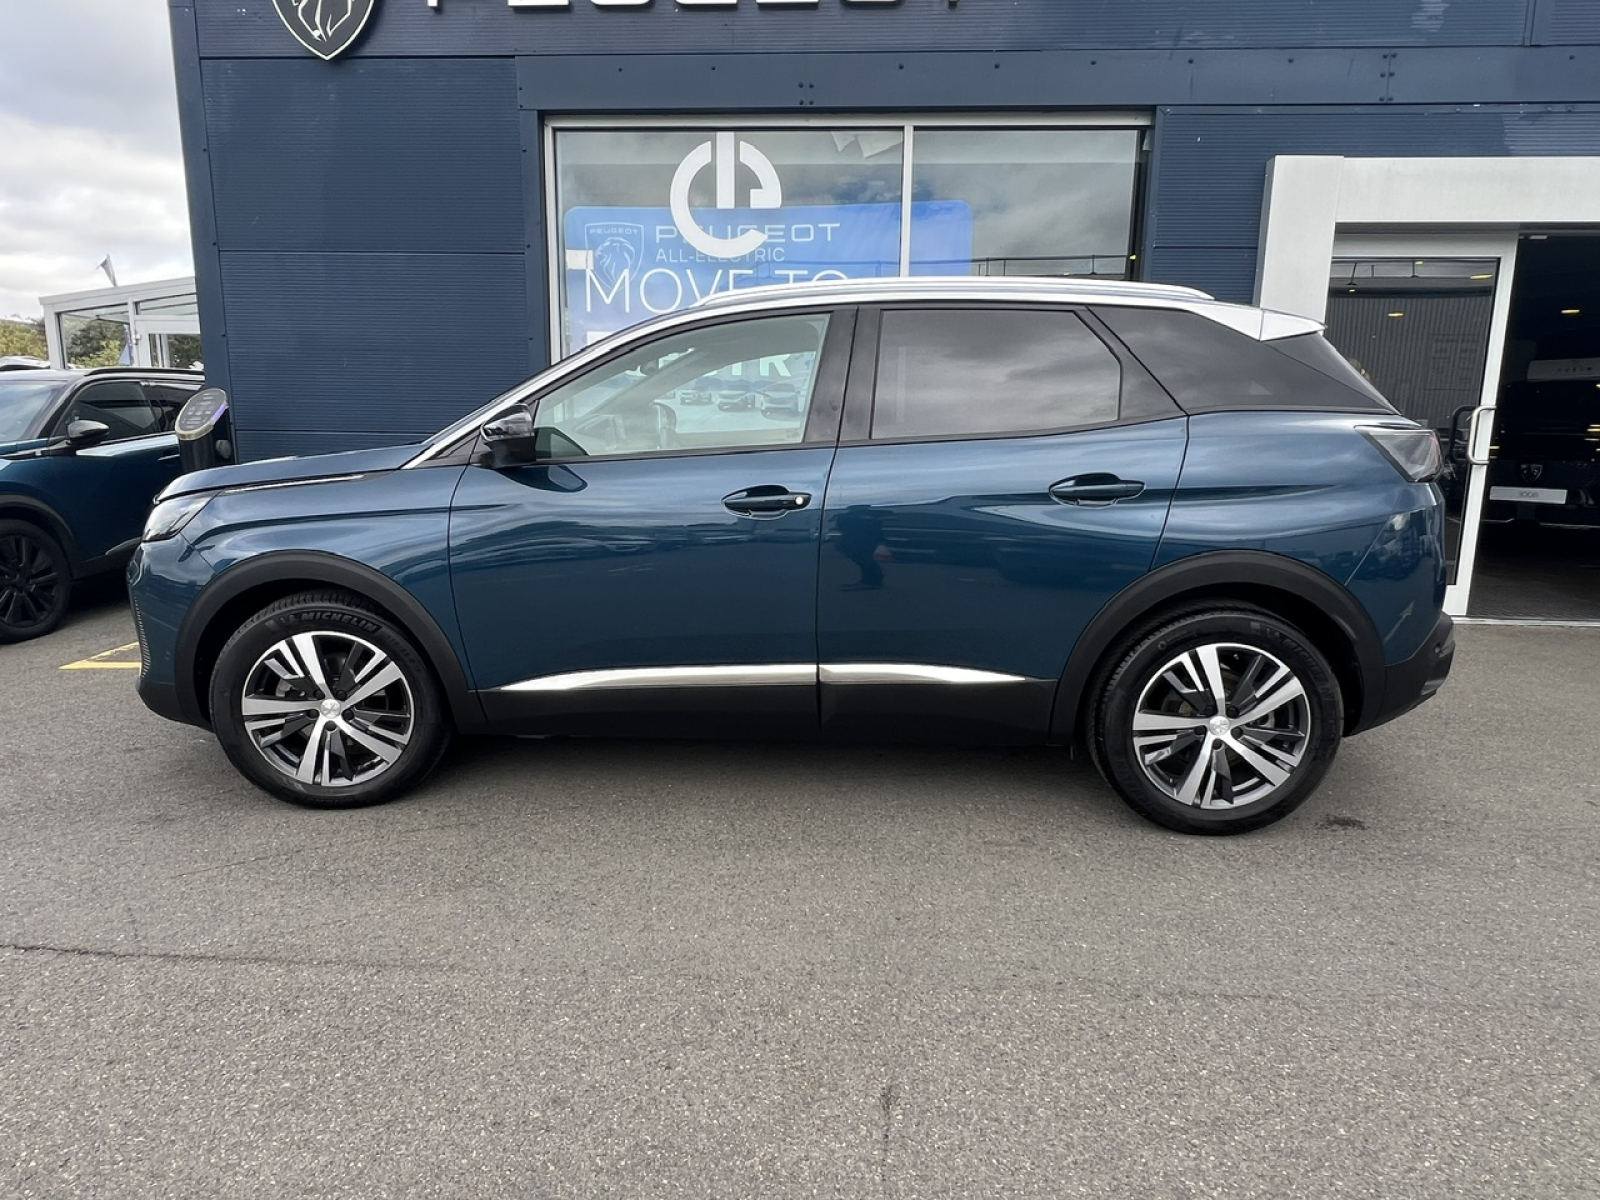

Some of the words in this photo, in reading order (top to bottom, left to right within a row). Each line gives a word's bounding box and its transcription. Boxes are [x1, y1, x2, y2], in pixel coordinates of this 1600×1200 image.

[589, 227, 639, 235] PEUGEOT
[655, 223, 841, 244] PUEOT
[655, 247, 785, 263] ALL-ELRIC
[301, 611, 378, 632] MICHELIN
